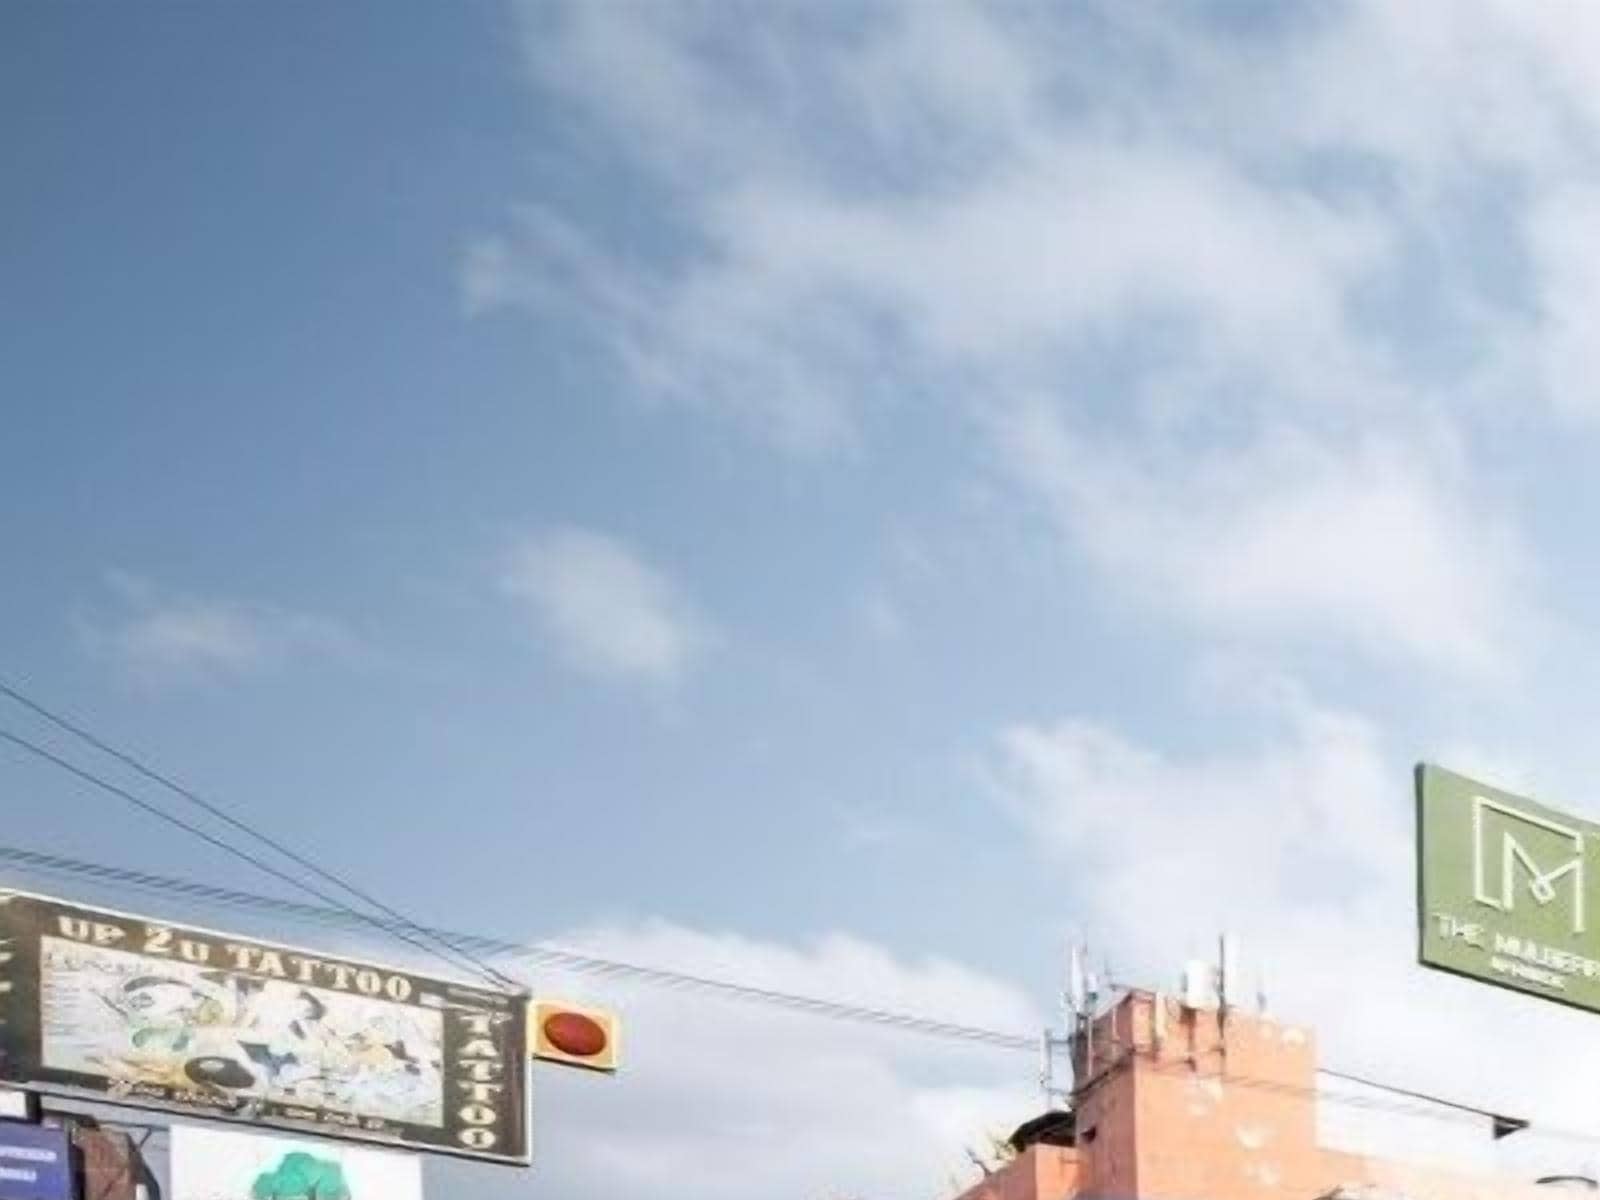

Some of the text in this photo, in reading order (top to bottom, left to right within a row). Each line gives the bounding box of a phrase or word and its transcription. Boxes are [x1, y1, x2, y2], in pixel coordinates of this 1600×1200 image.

[58, 916, 126, 945] UP
[224, 942, 412, 1001] TATTOO
[458, 1011, 505, 1150] TATTOO
